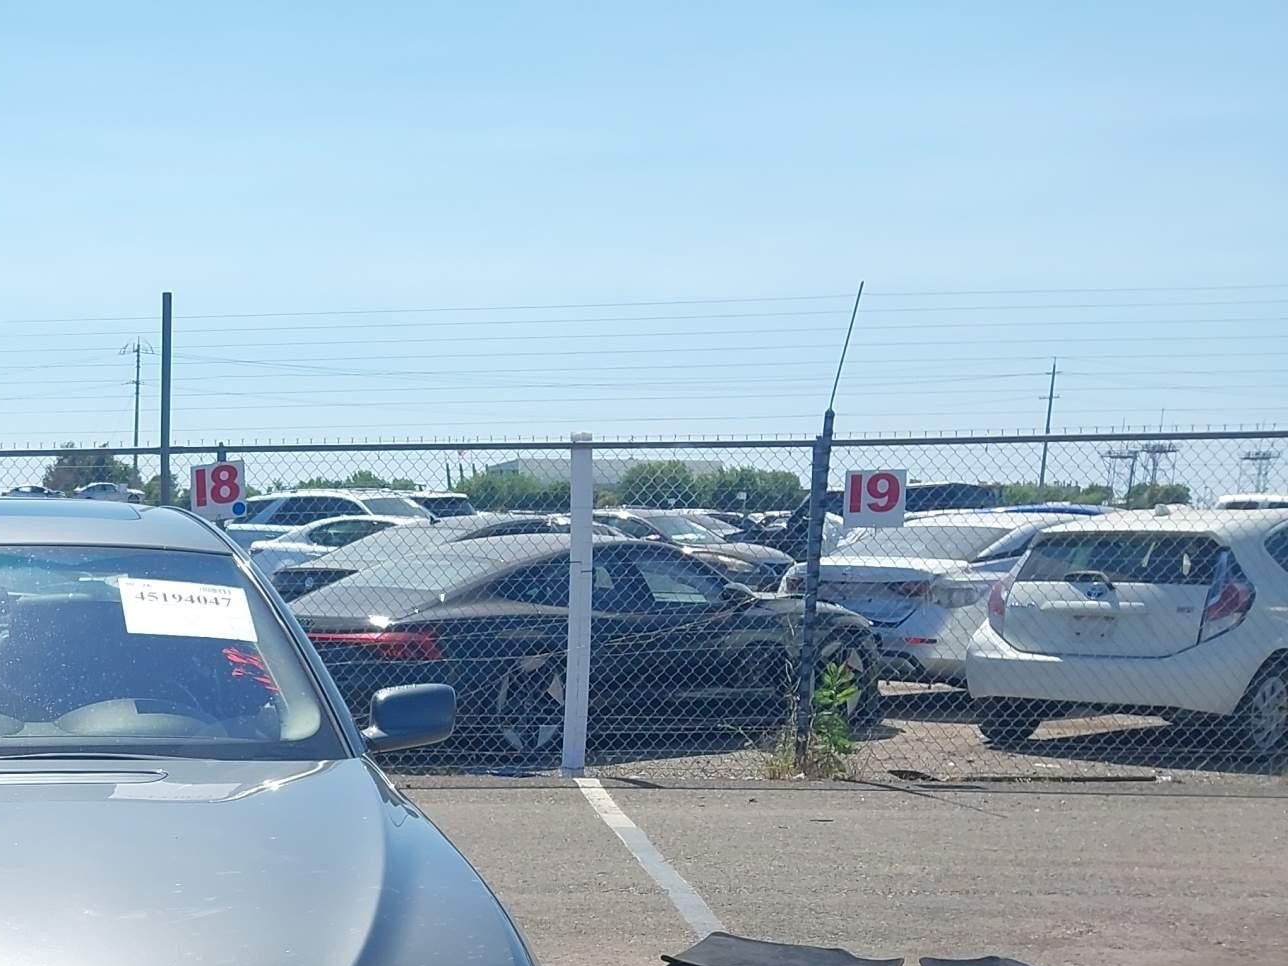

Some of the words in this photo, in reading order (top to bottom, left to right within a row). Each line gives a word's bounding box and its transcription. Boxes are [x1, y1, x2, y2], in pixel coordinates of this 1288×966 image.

[195, 464, 240, 507] 18
[849, 473, 900, 513] 19
[135, 591, 231, 608] 45194047
